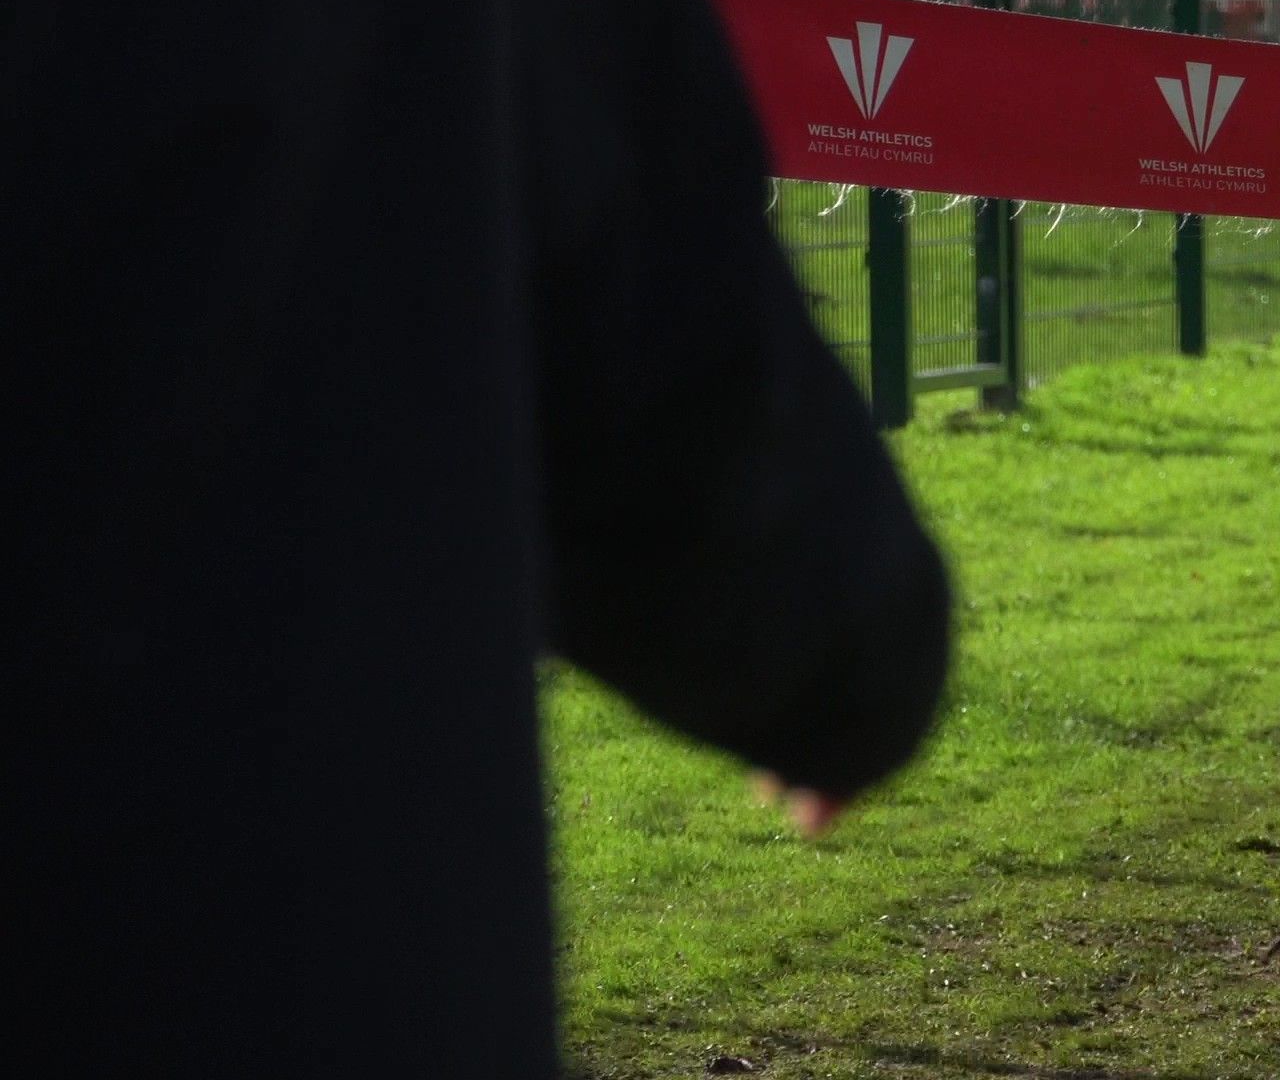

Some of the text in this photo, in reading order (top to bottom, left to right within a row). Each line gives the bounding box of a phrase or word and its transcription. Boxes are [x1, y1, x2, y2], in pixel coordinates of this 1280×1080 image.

[808, 124, 932, 148] WELSH ATHLETICS
[808, 141, 933, 164] ATHLETAU CYMRU
[1139, 159, 1265, 178] WELSH ATHLETICS
[1140, 174, 1266, 194] ATHLETAU CYMRU
